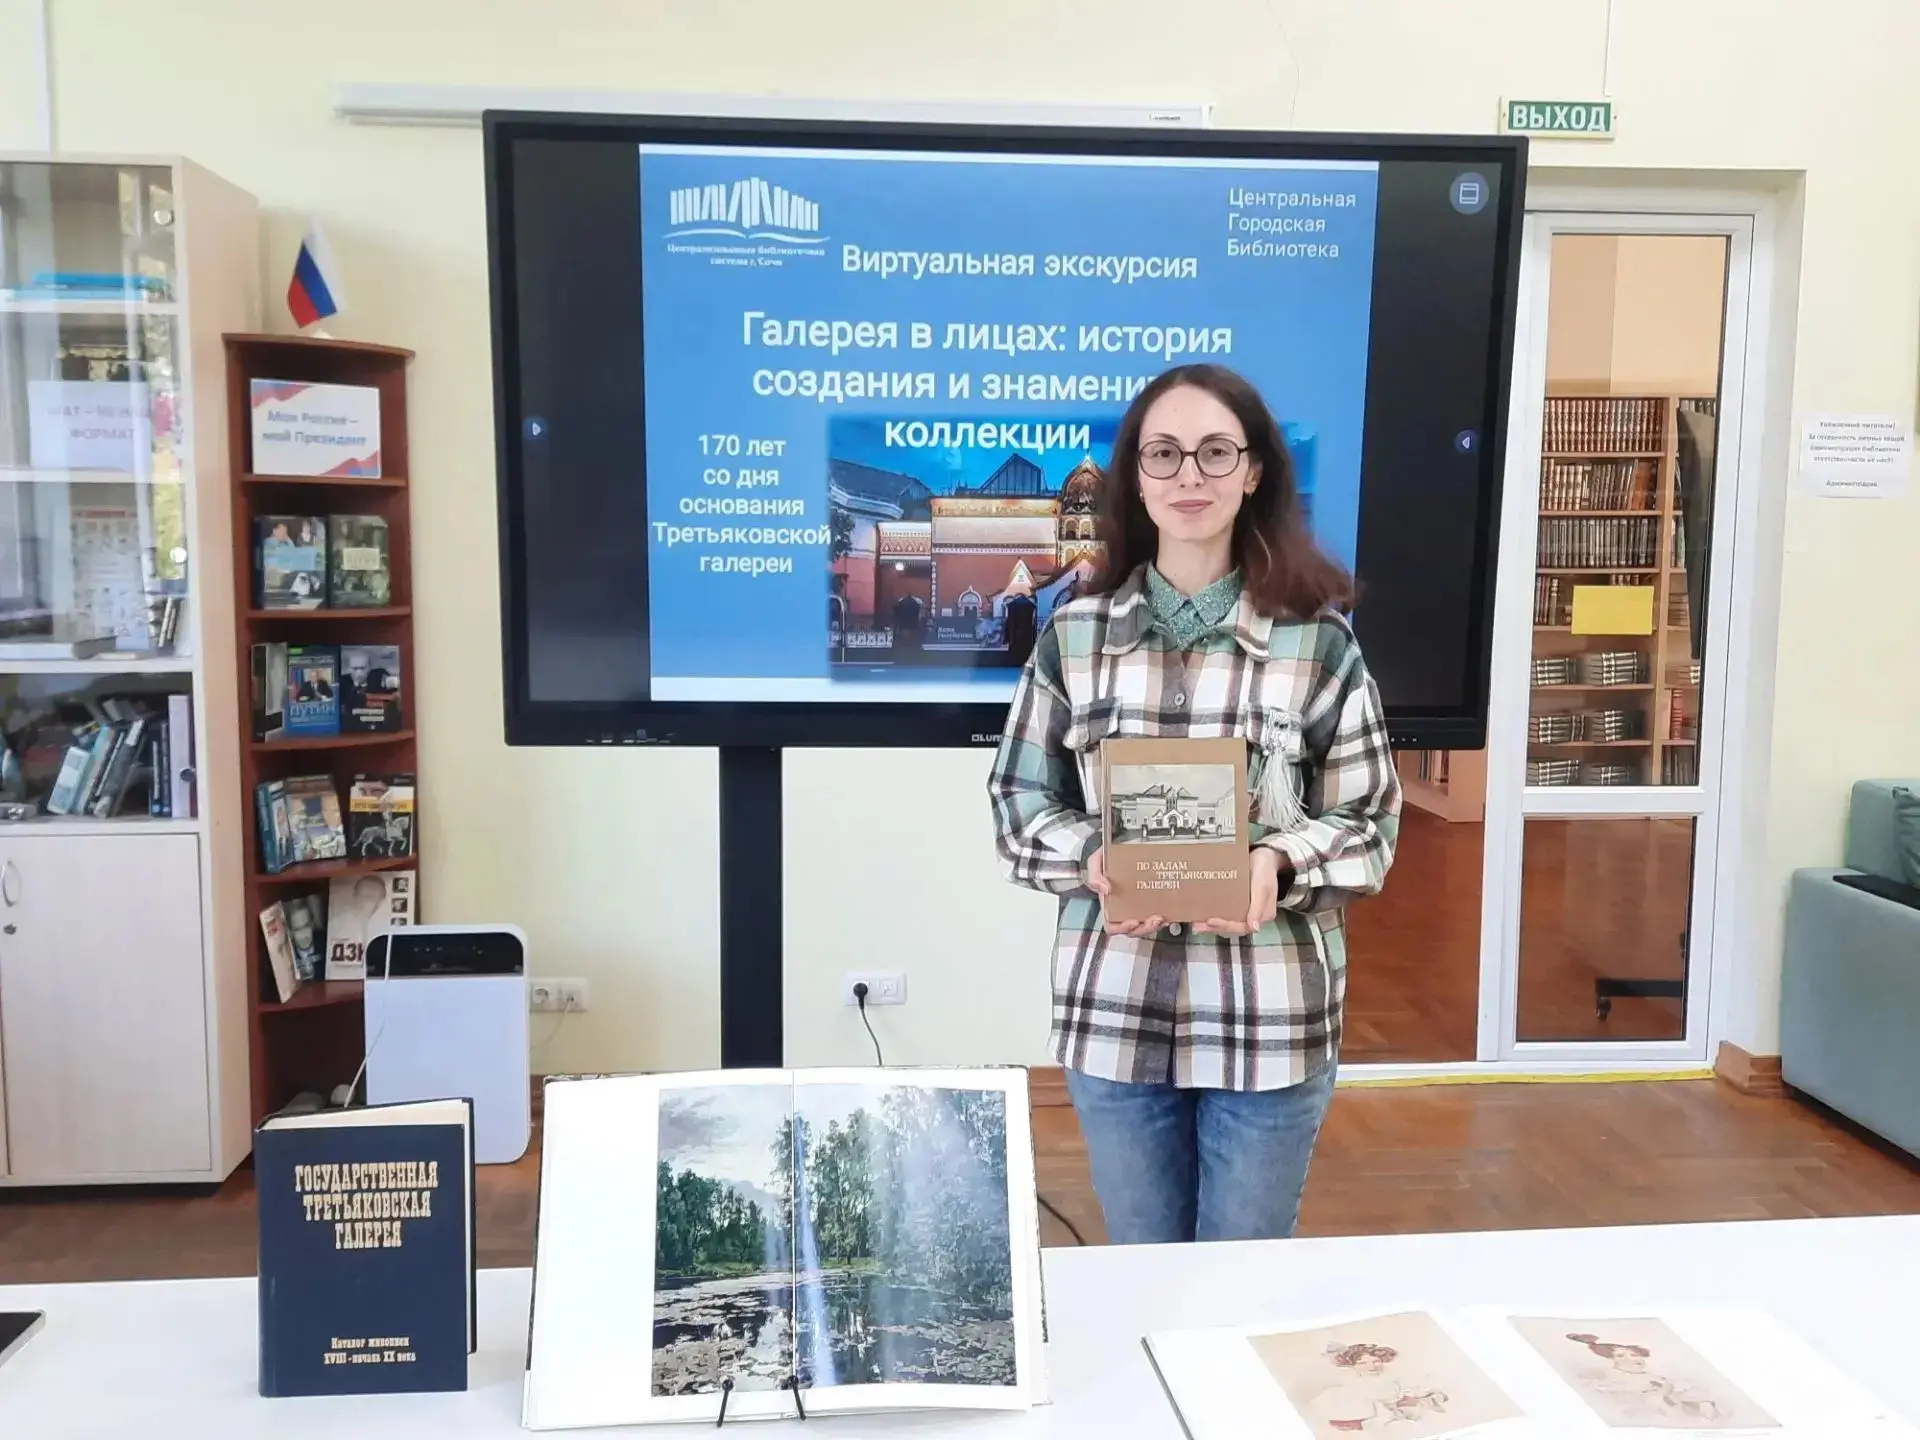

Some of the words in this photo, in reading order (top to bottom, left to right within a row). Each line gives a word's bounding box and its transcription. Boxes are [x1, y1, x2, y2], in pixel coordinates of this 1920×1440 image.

[1512, 104, 1606, 132] ВЫХОД
[1228, 187, 1357, 210] Центральная
[1228, 212, 1326, 235] Городская
[1227, 238, 1340, 258] Библиотека
[842, 244, 1035, 280] Виртуальная
[1044, 252, 1199, 284] экскурсия
[743, 311, 898, 356] Галерея
[910, 321, 933, 350] в
[942, 322, 1067, 357] лицах:
[1078, 325, 1232, 362] история
[752, 368, 936, 404] создания
[948, 372, 970, 400] и
[981, 371, 1157, 402] знамени
[698, 434, 741, 457] 170
[746, 438, 787, 457] лет
[885, 420, 1091, 454] коллекции
[703, 468, 732, 486] со
[736, 468, 780, 489] дня
[679, 497, 805, 516] основания
[652, 521, 832, 548] Третьяковской
[699, 556, 793, 578] галереи
[1136, 861, 1150, 871] ПО
[1152, 860, 1188, 871] ЗАЛАМ
[1155, 870, 1238, 880] ТРЕТЬЯКОВСКОЙ
[1136, 880, 1180, 890] ГАЛЕРЕИ
[294, 1160, 439, 1193] ГОСУДАРСТВЕННАЯ
[302, 1190, 432, 1221] ТРЕТЬЯКОВСКАЯ
[334, 1220, 402, 1250] ГАЛЕРЕЯ
[330, 1337, 366, 1350] Каталог
[367, 1336, 410, 1348] живописи
